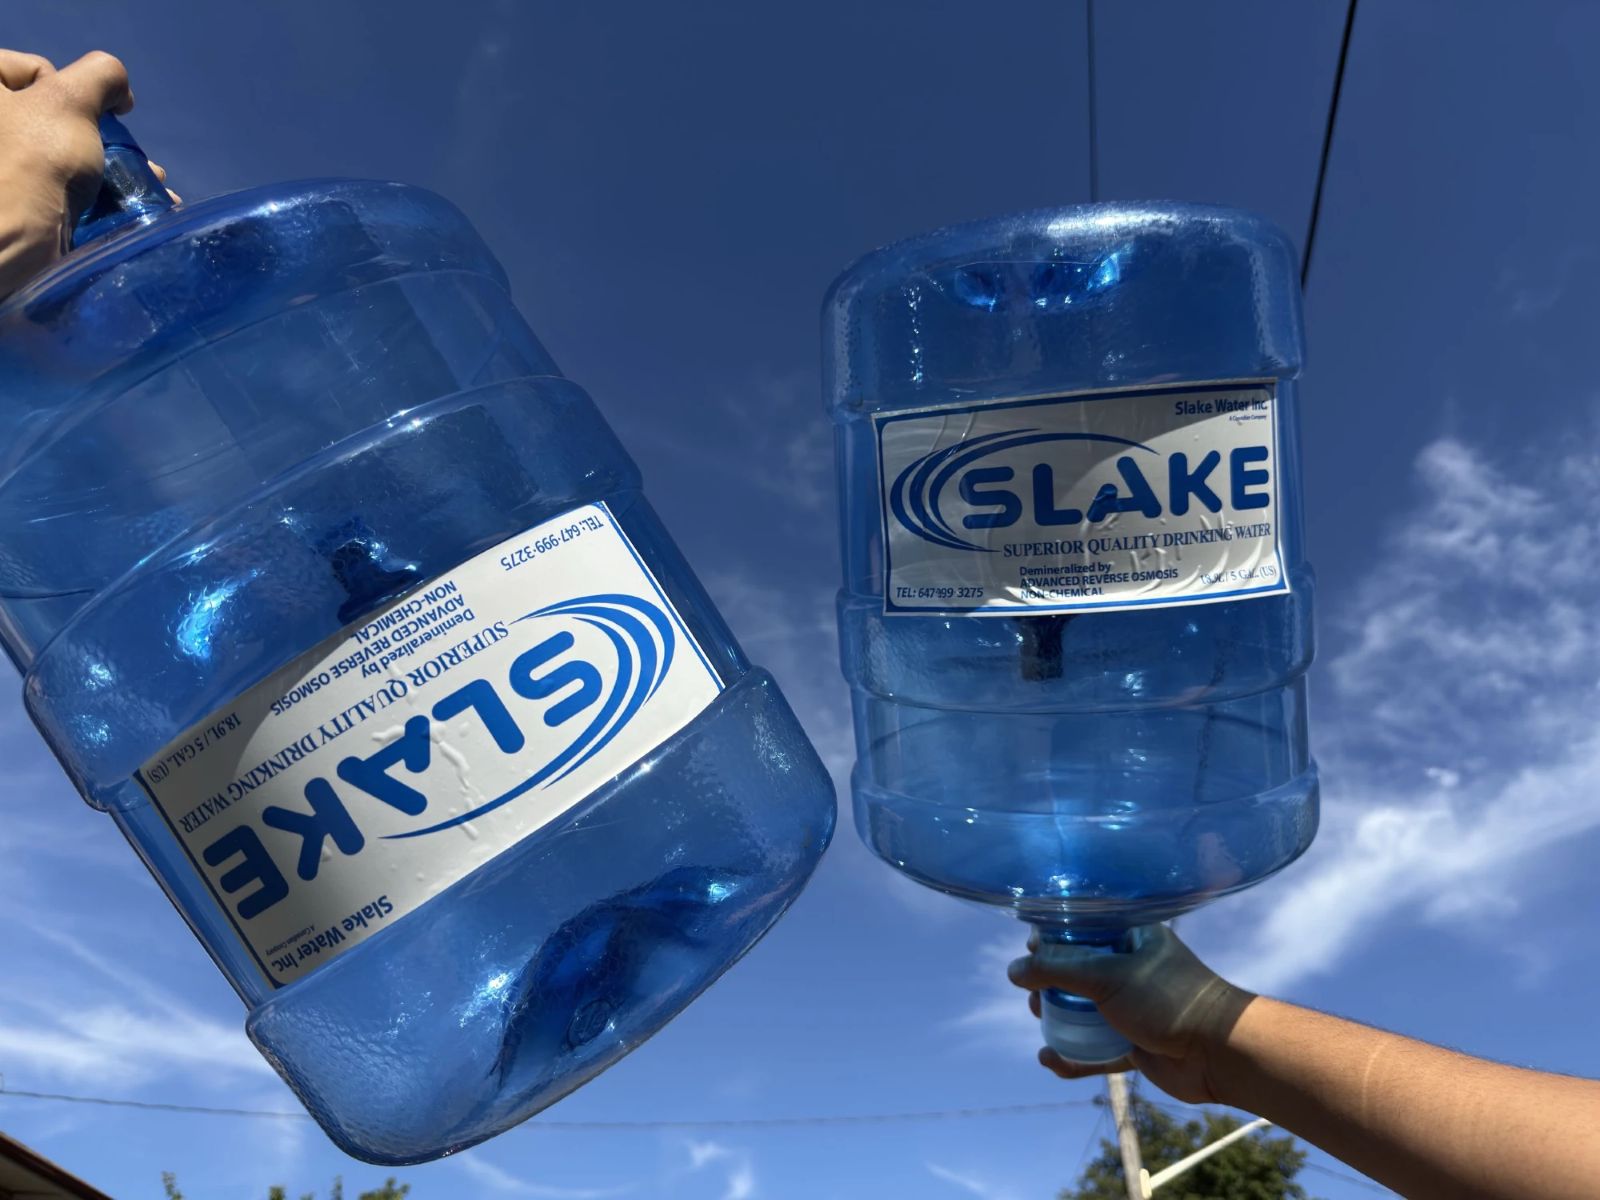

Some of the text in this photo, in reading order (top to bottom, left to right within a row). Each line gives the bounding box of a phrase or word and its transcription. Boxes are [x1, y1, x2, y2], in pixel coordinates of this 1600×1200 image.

[1175, 400, 1213, 416] Slake
[1215, 398, 1250, 412] Water
[959, 446, 1270, 530] SLAKE
[578, 515, 604, 532] TEL:
[1003, 522, 1271, 557] SUPERIOR QUALITY DRINKING WATER
[1019, 562, 1112, 576] Demineralized by
[1020, 568, 1179, 588] ADVANCED REVERSE OSMOSIS
[1230, 570, 1237, 581] 5
[896, 586, 917, 598] TEL:
[349, 581, 457, 644] NON-CHEMICAL
[267, 594, 464, 716] ADVANCED REVERSE OSMOSIS
[361, 609, 475, 679] Demineralized by
[178, 621, 508, 834] SUPERIOR QUALITY DRINKING WATER
[208, 712, 242, 740] 18.9L
[193, 736, 205, 752] 5
[146, 759, 170, 784] (US)
[202, 631, 603, 920] SLAKE
[271, 895, 393, 972] Slake Water Inc.
